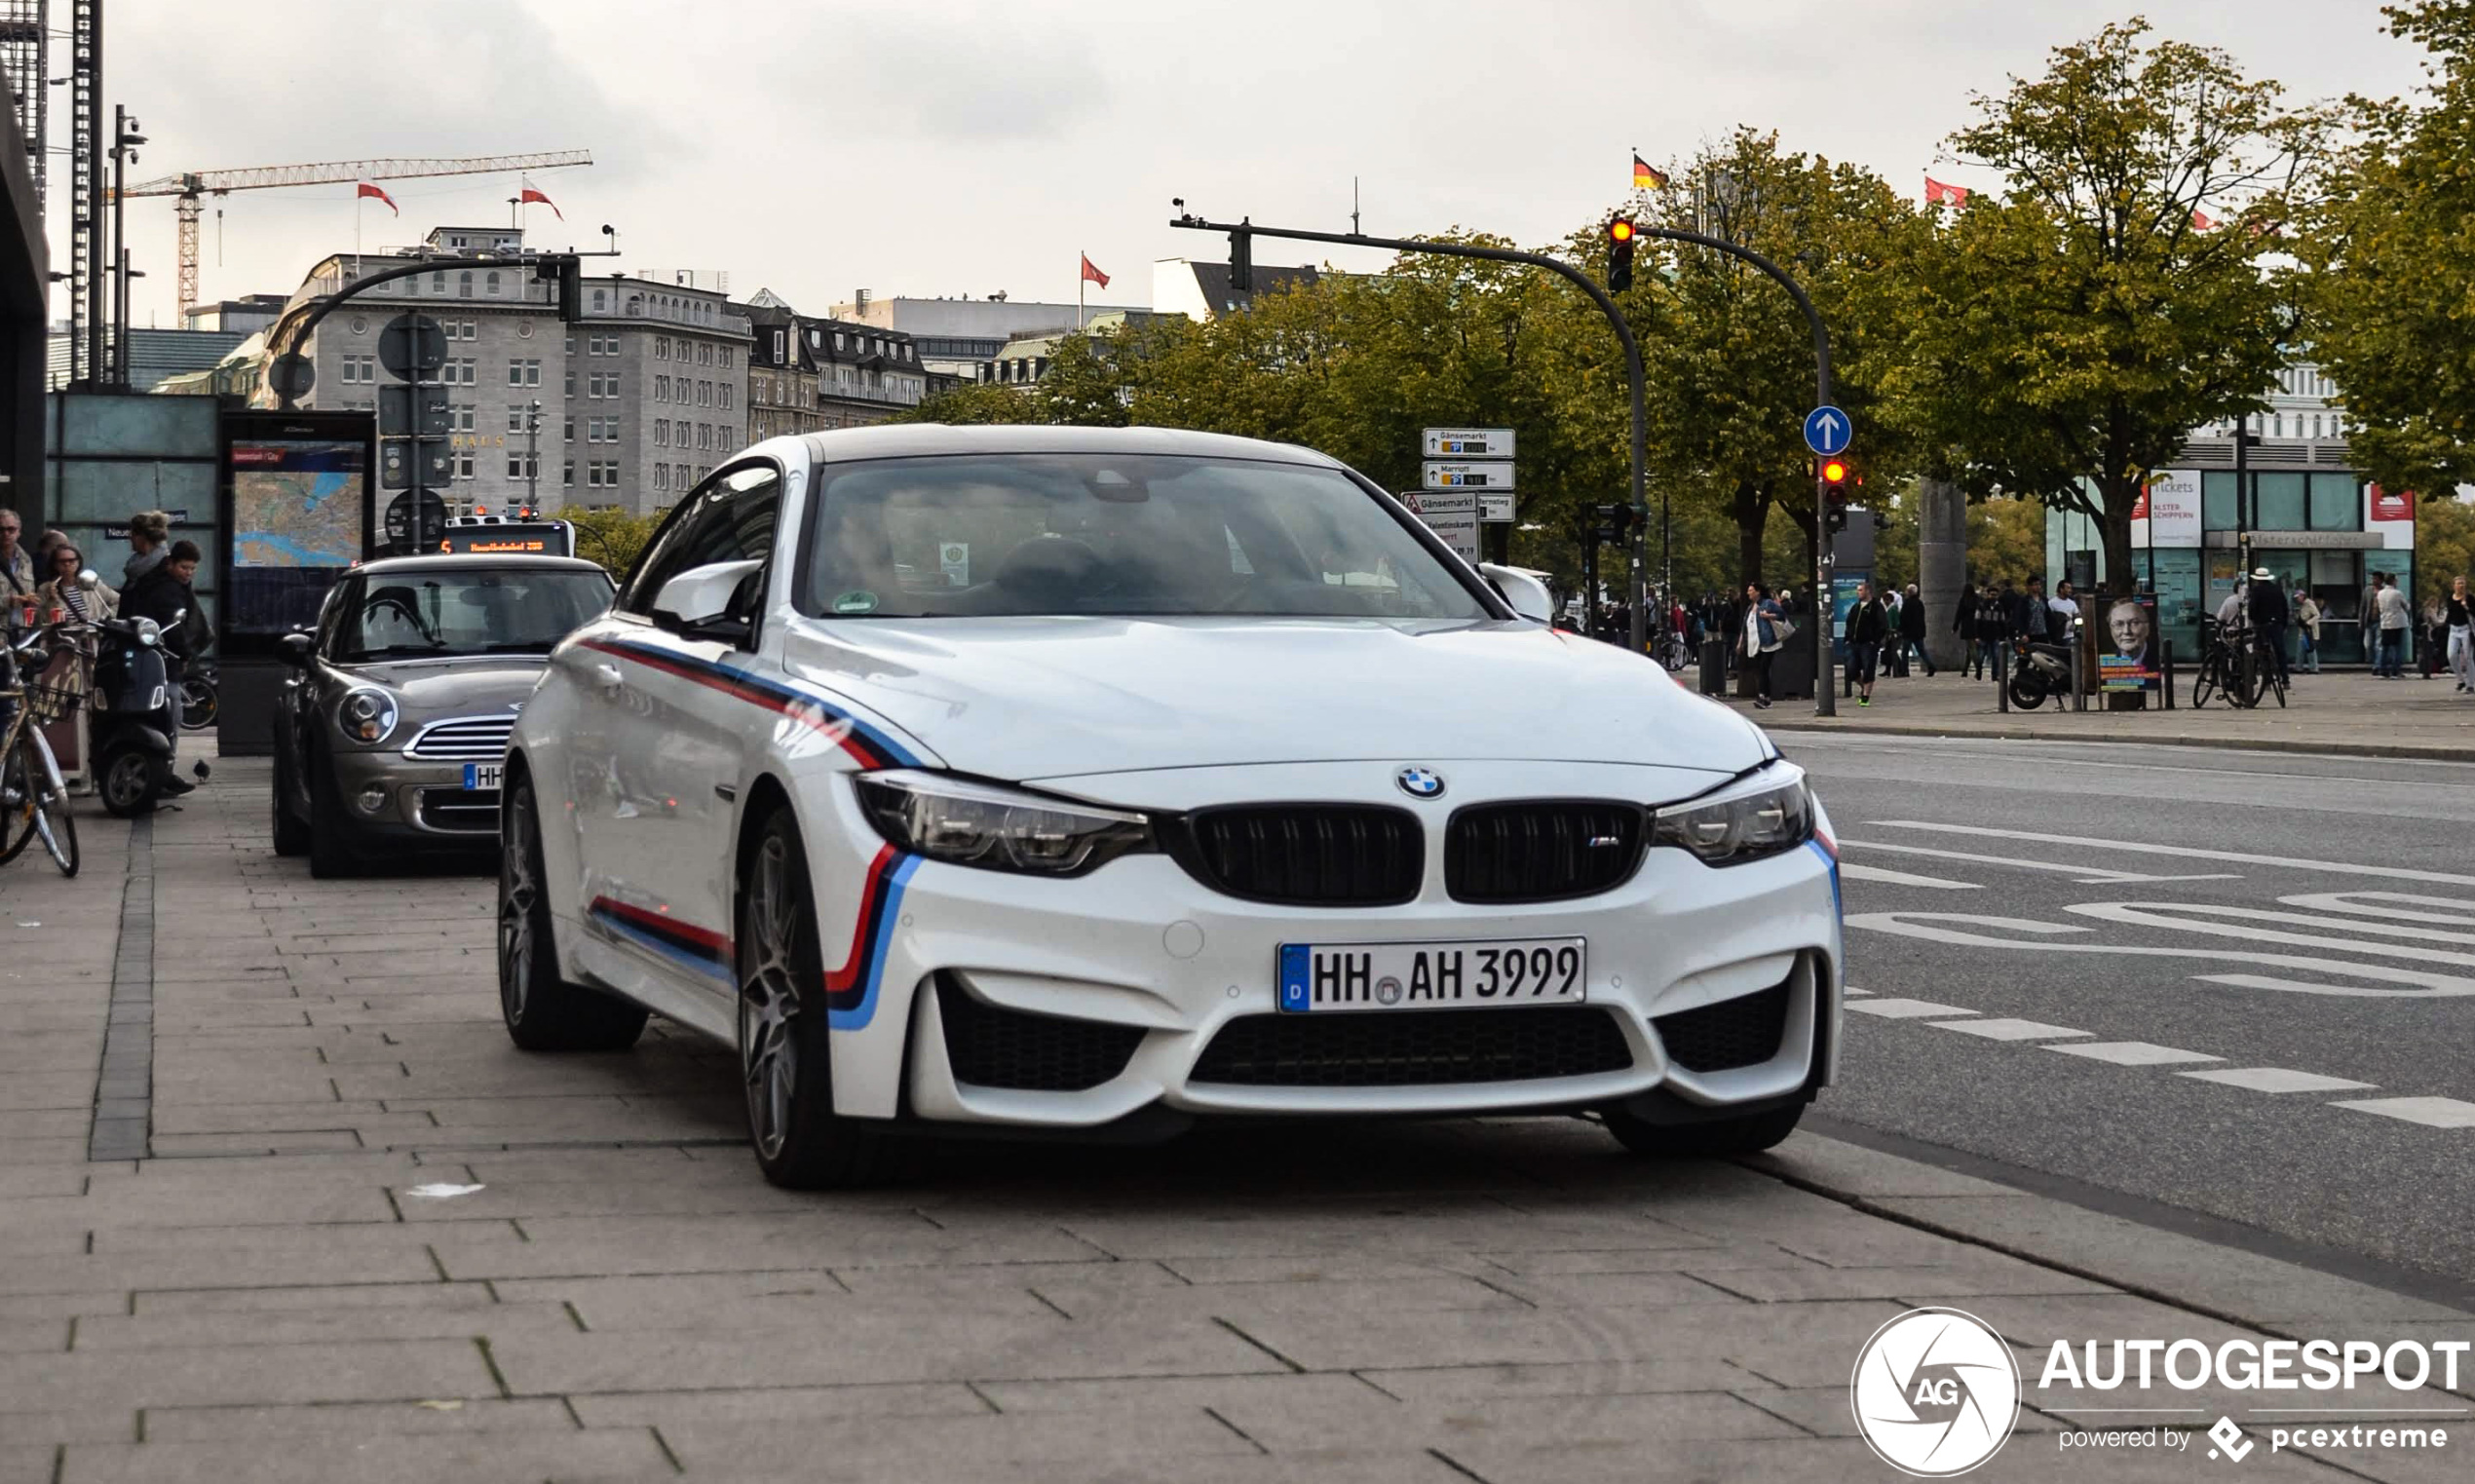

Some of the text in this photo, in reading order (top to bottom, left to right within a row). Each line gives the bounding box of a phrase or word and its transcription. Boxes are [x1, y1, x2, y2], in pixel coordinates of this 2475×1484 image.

[1440, 431, 1487, 440] Gänsemarkt
[2154, 480, 2194, 493] Tickets
[1421, 498, 1473, 509] Gänsemarkt
[1289, 946, 1580, 1003] D HH AH 3999
